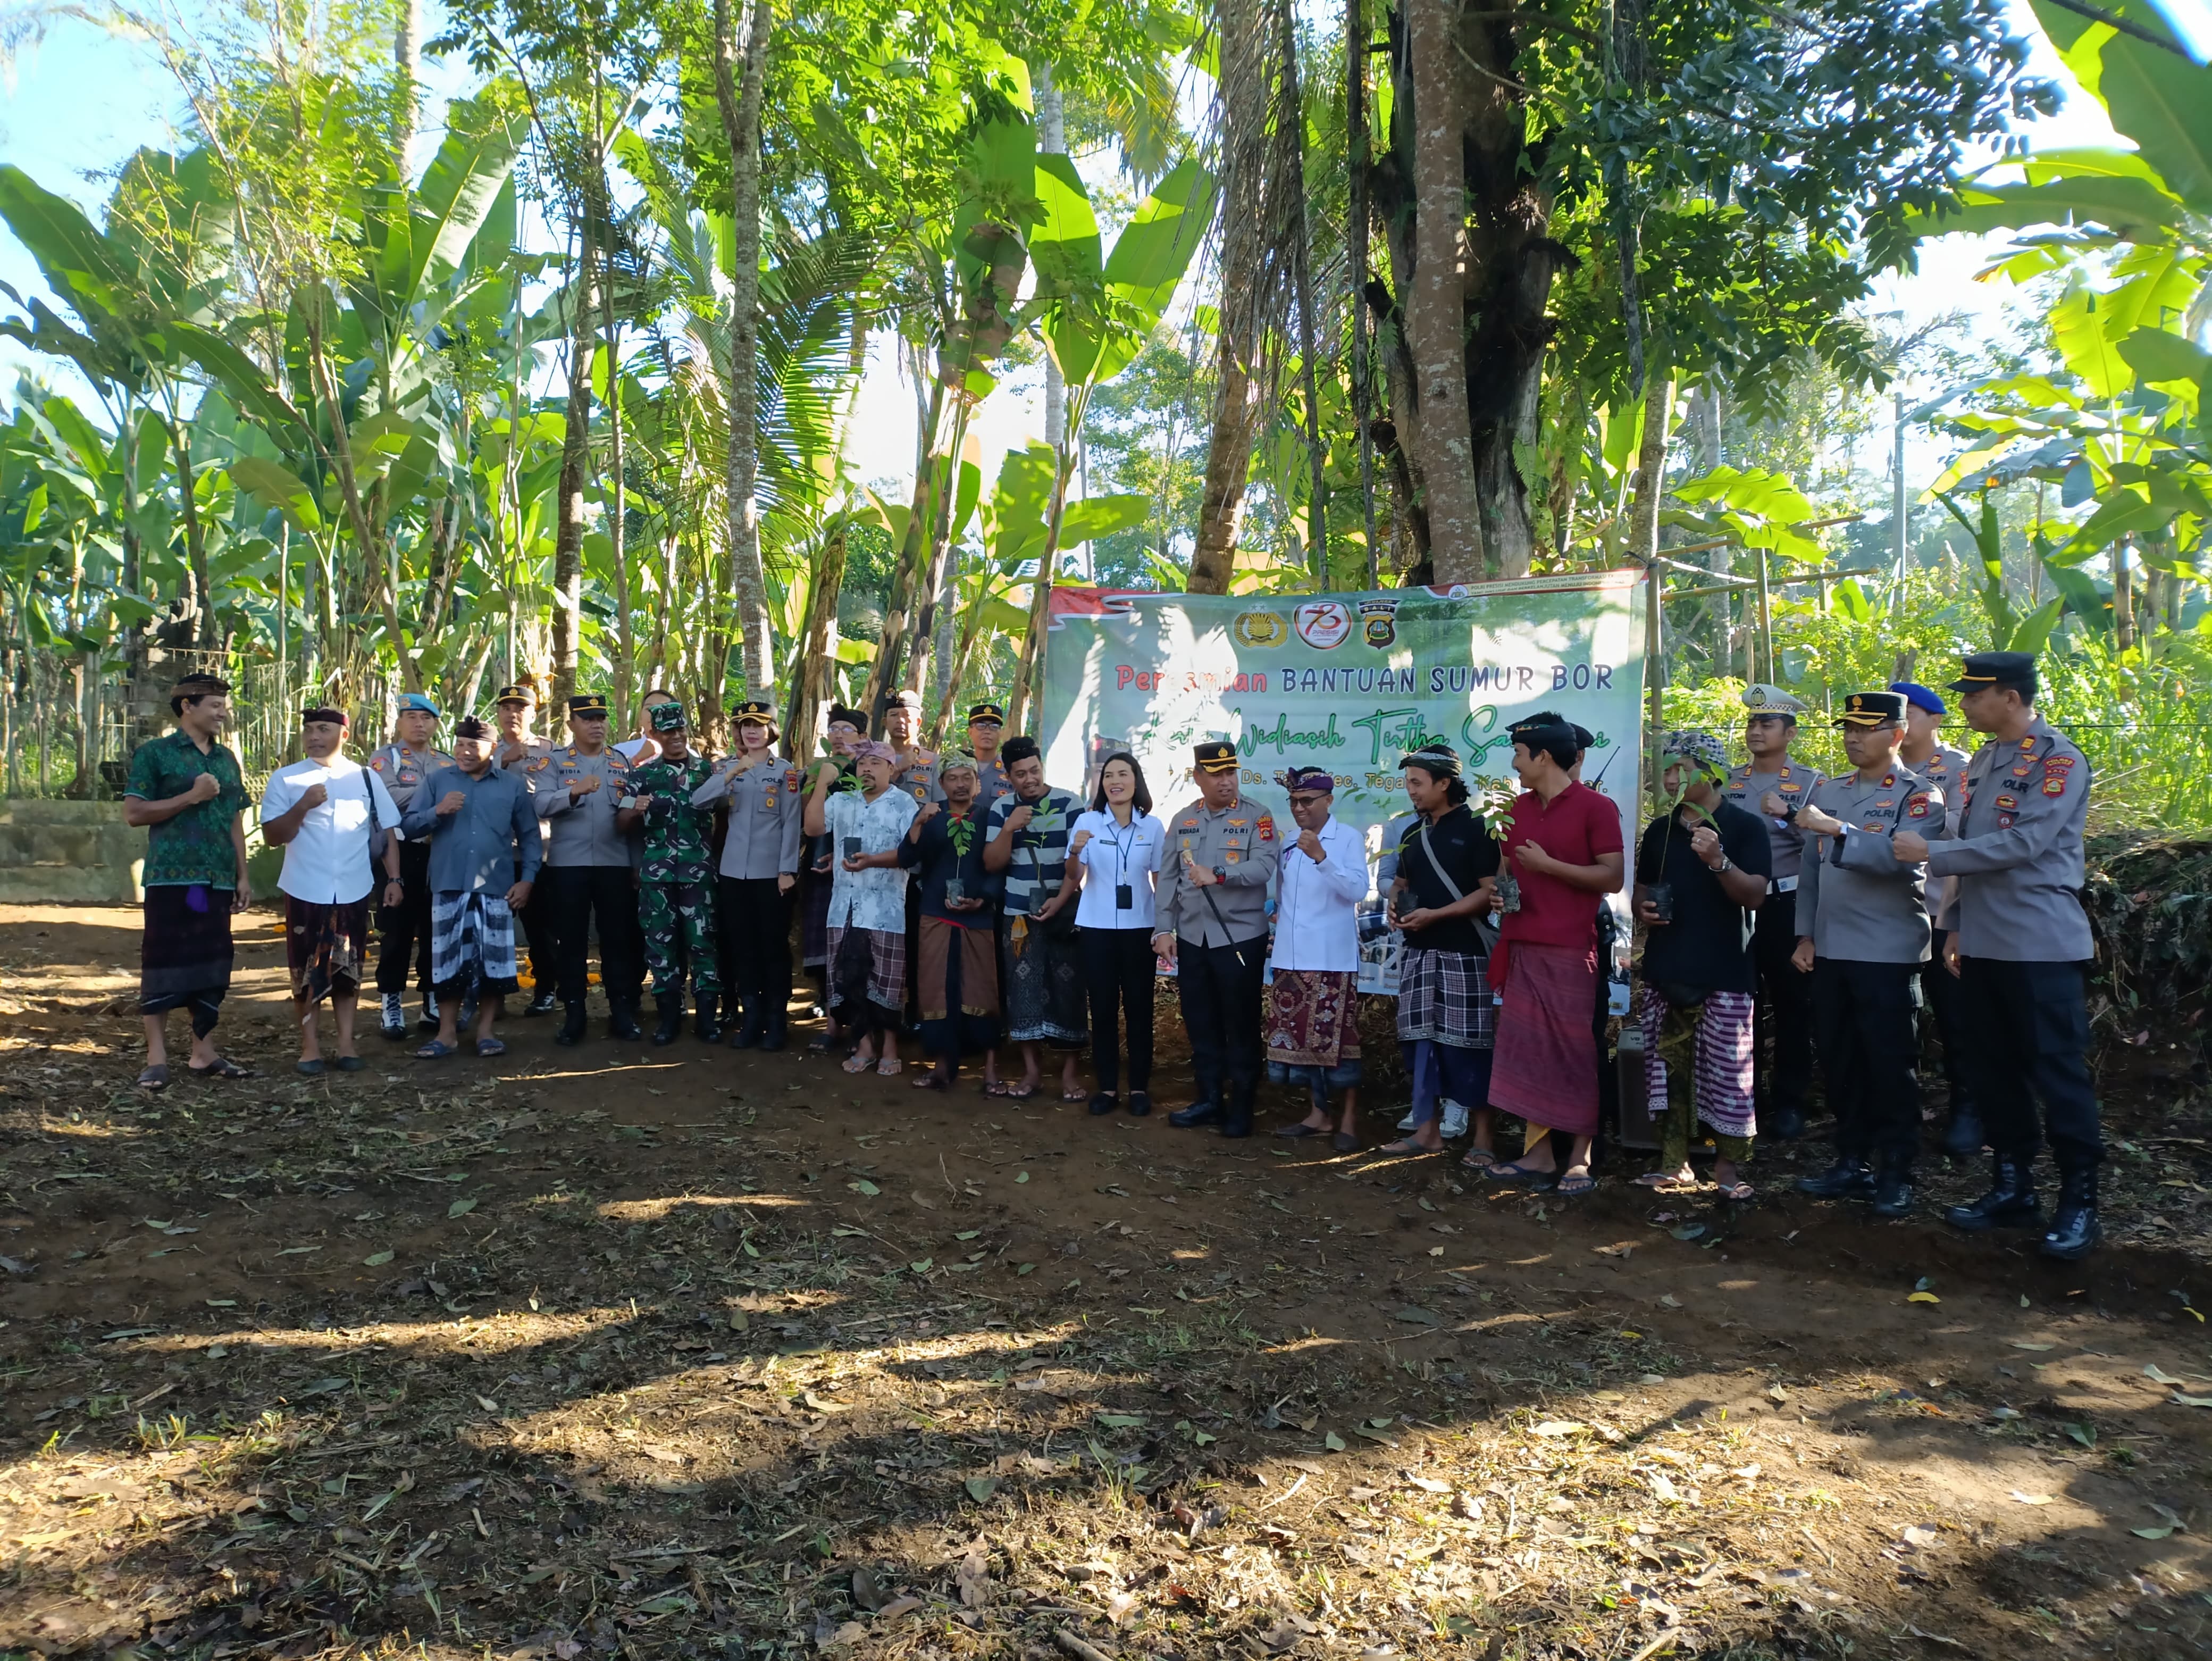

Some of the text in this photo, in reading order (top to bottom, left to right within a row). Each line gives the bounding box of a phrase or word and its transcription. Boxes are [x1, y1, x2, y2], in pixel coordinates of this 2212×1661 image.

[1281, 667, 1415, 694] BANTUAN
[1430, 665, 1534, 694] SUMUR
[1551, 663, 1613, 691] BOR
[1241, 769, 1267, 785] Ds.
[1330, 771, 1358, 788] ec.
[1863, 809, 1895, 817] POLRI
